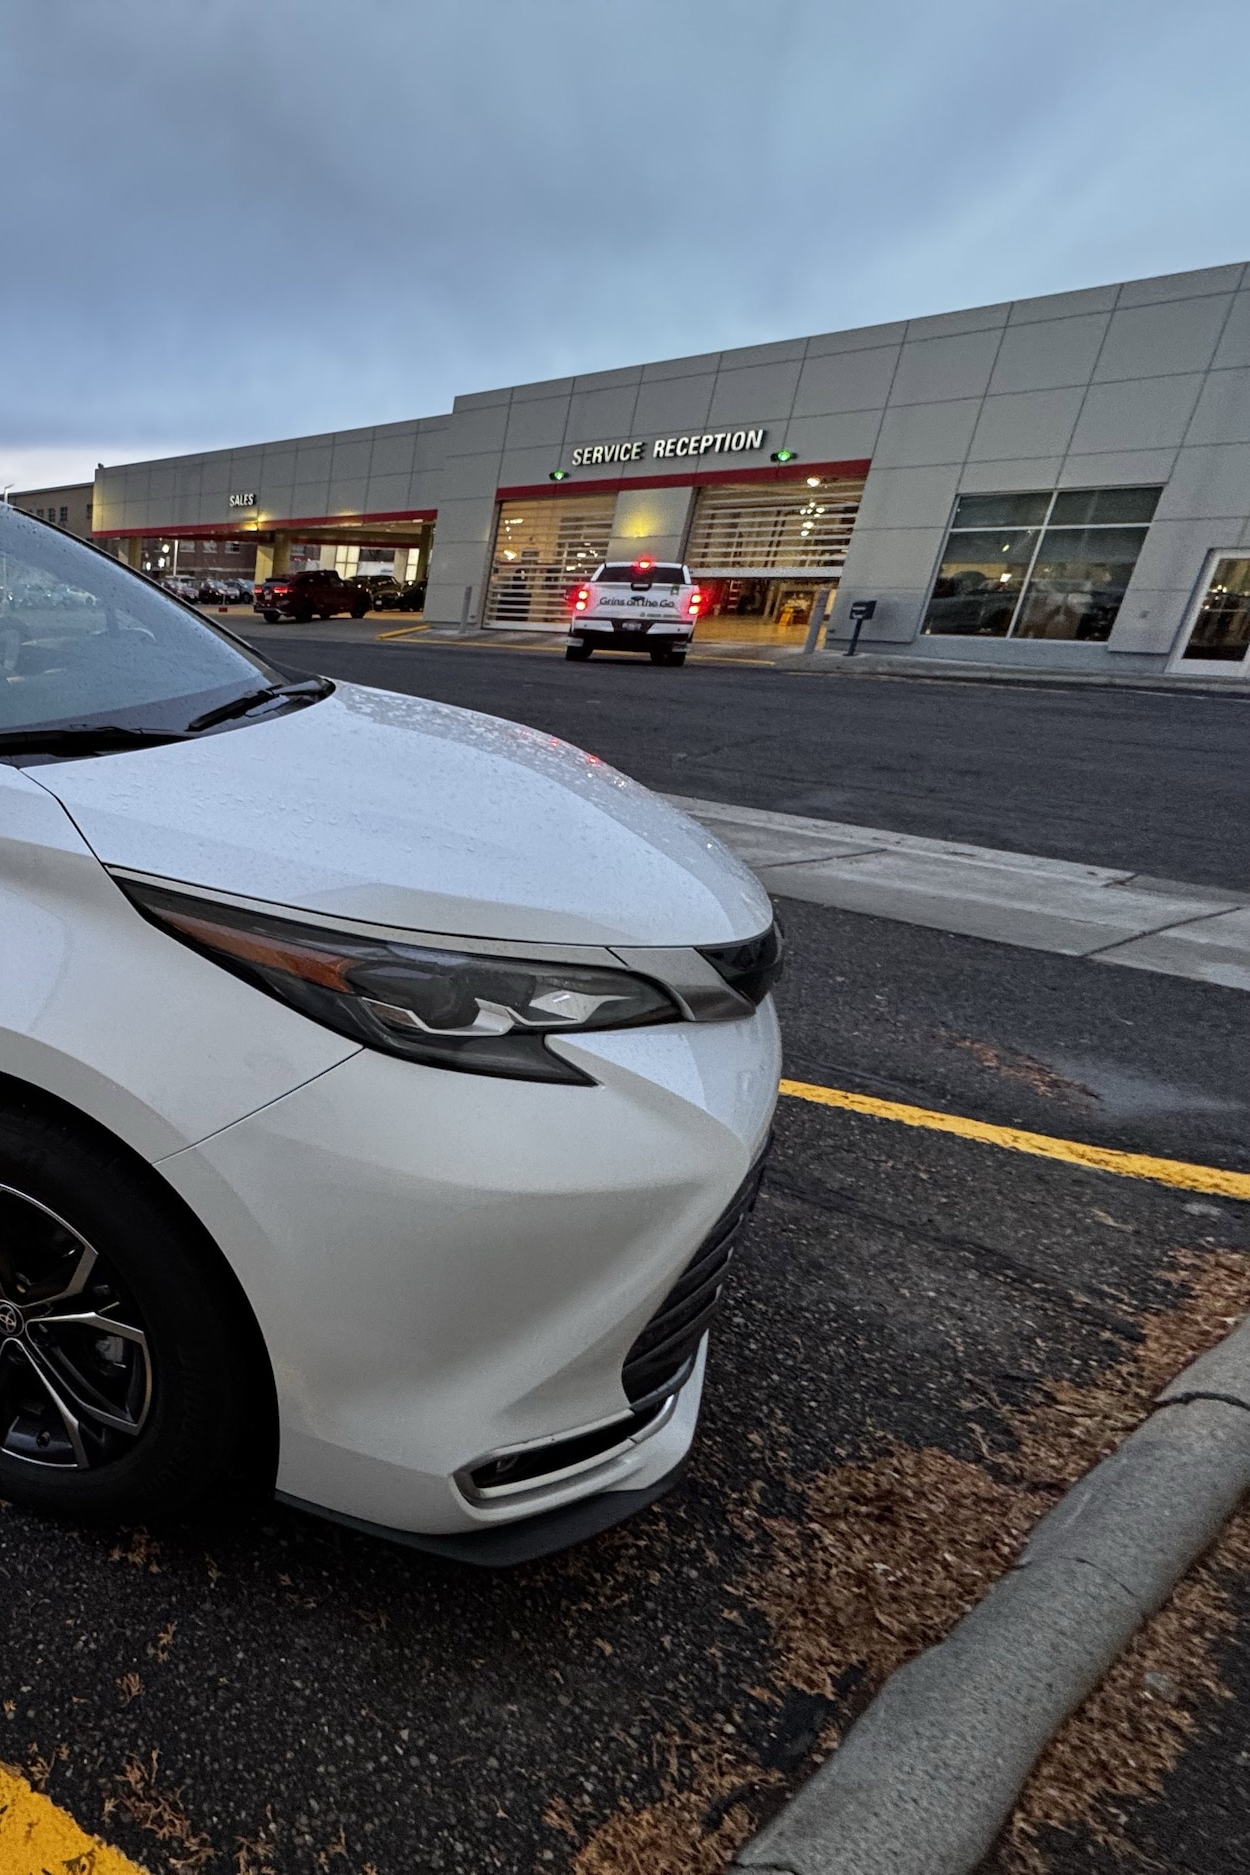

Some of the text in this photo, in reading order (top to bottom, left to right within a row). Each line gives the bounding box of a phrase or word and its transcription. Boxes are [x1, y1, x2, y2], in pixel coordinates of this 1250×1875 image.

[572, 429, 764, 466] SERVICE RECEPTION
[229, 493, 255, 507] SALES
[599, 597, 625, 606] Grins
[641, 599, 658, 607] the
[659, 599, 675, 608] Go
